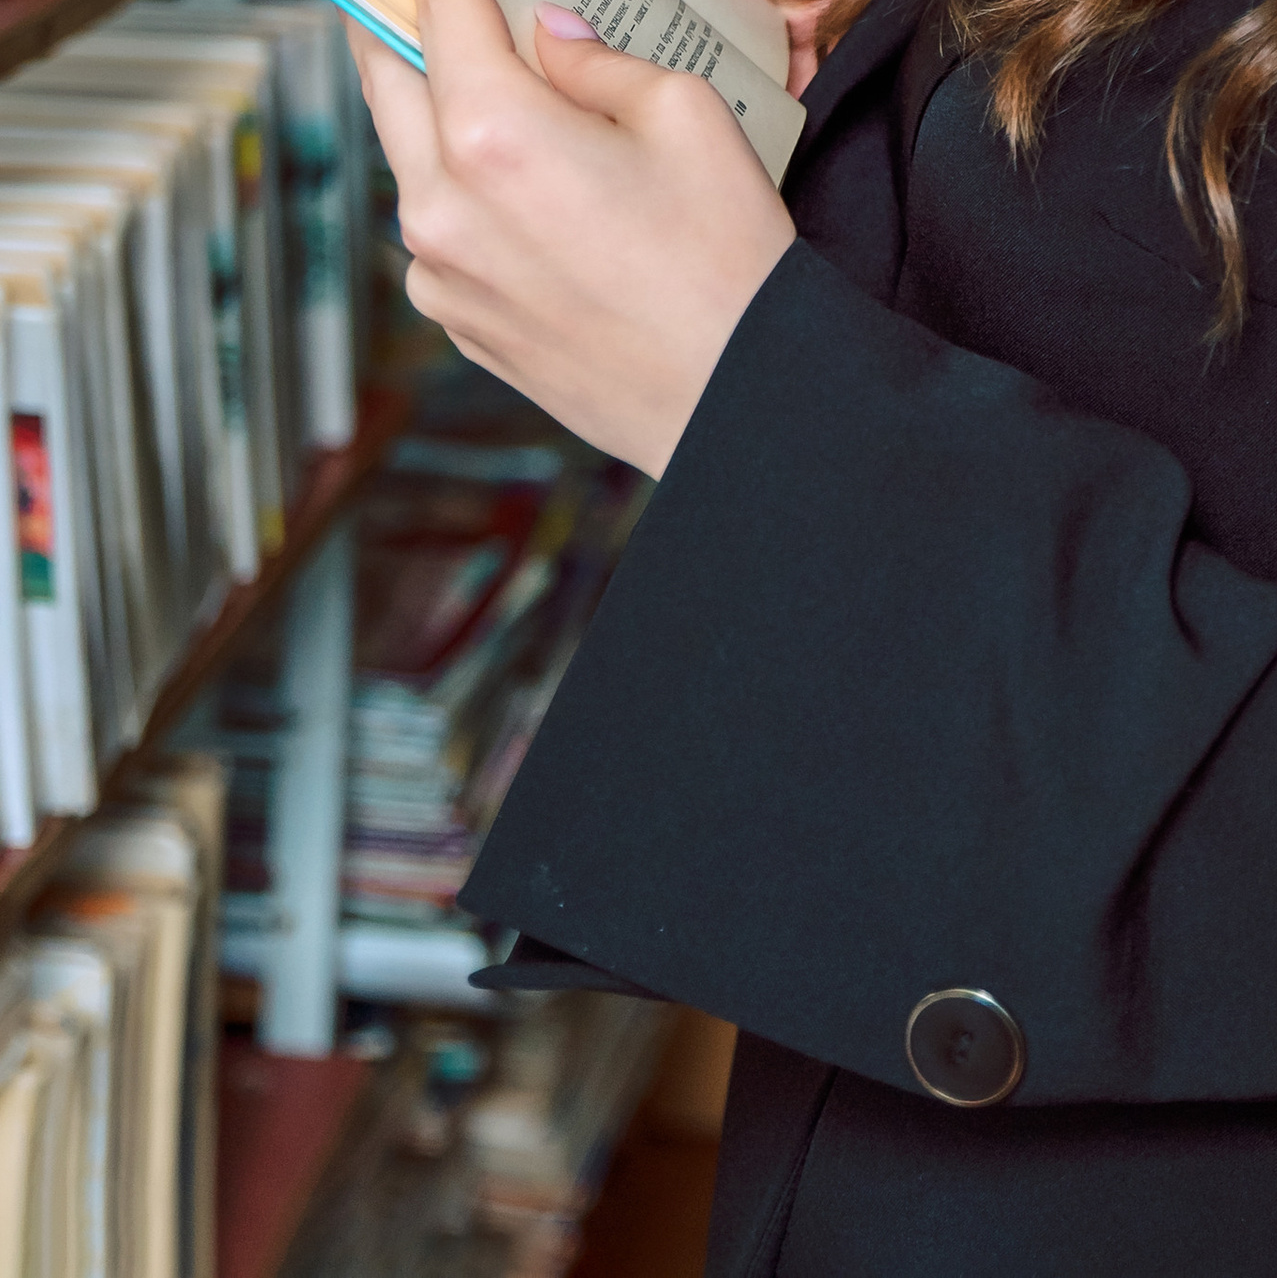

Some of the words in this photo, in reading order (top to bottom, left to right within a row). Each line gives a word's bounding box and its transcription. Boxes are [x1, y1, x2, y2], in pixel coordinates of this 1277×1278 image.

[588, 15, 602, 29] уду
[603, 1, 629, 40] прызнанне:
[656, 43, 666, 55] па
[734, 99, 747, 117] 110
